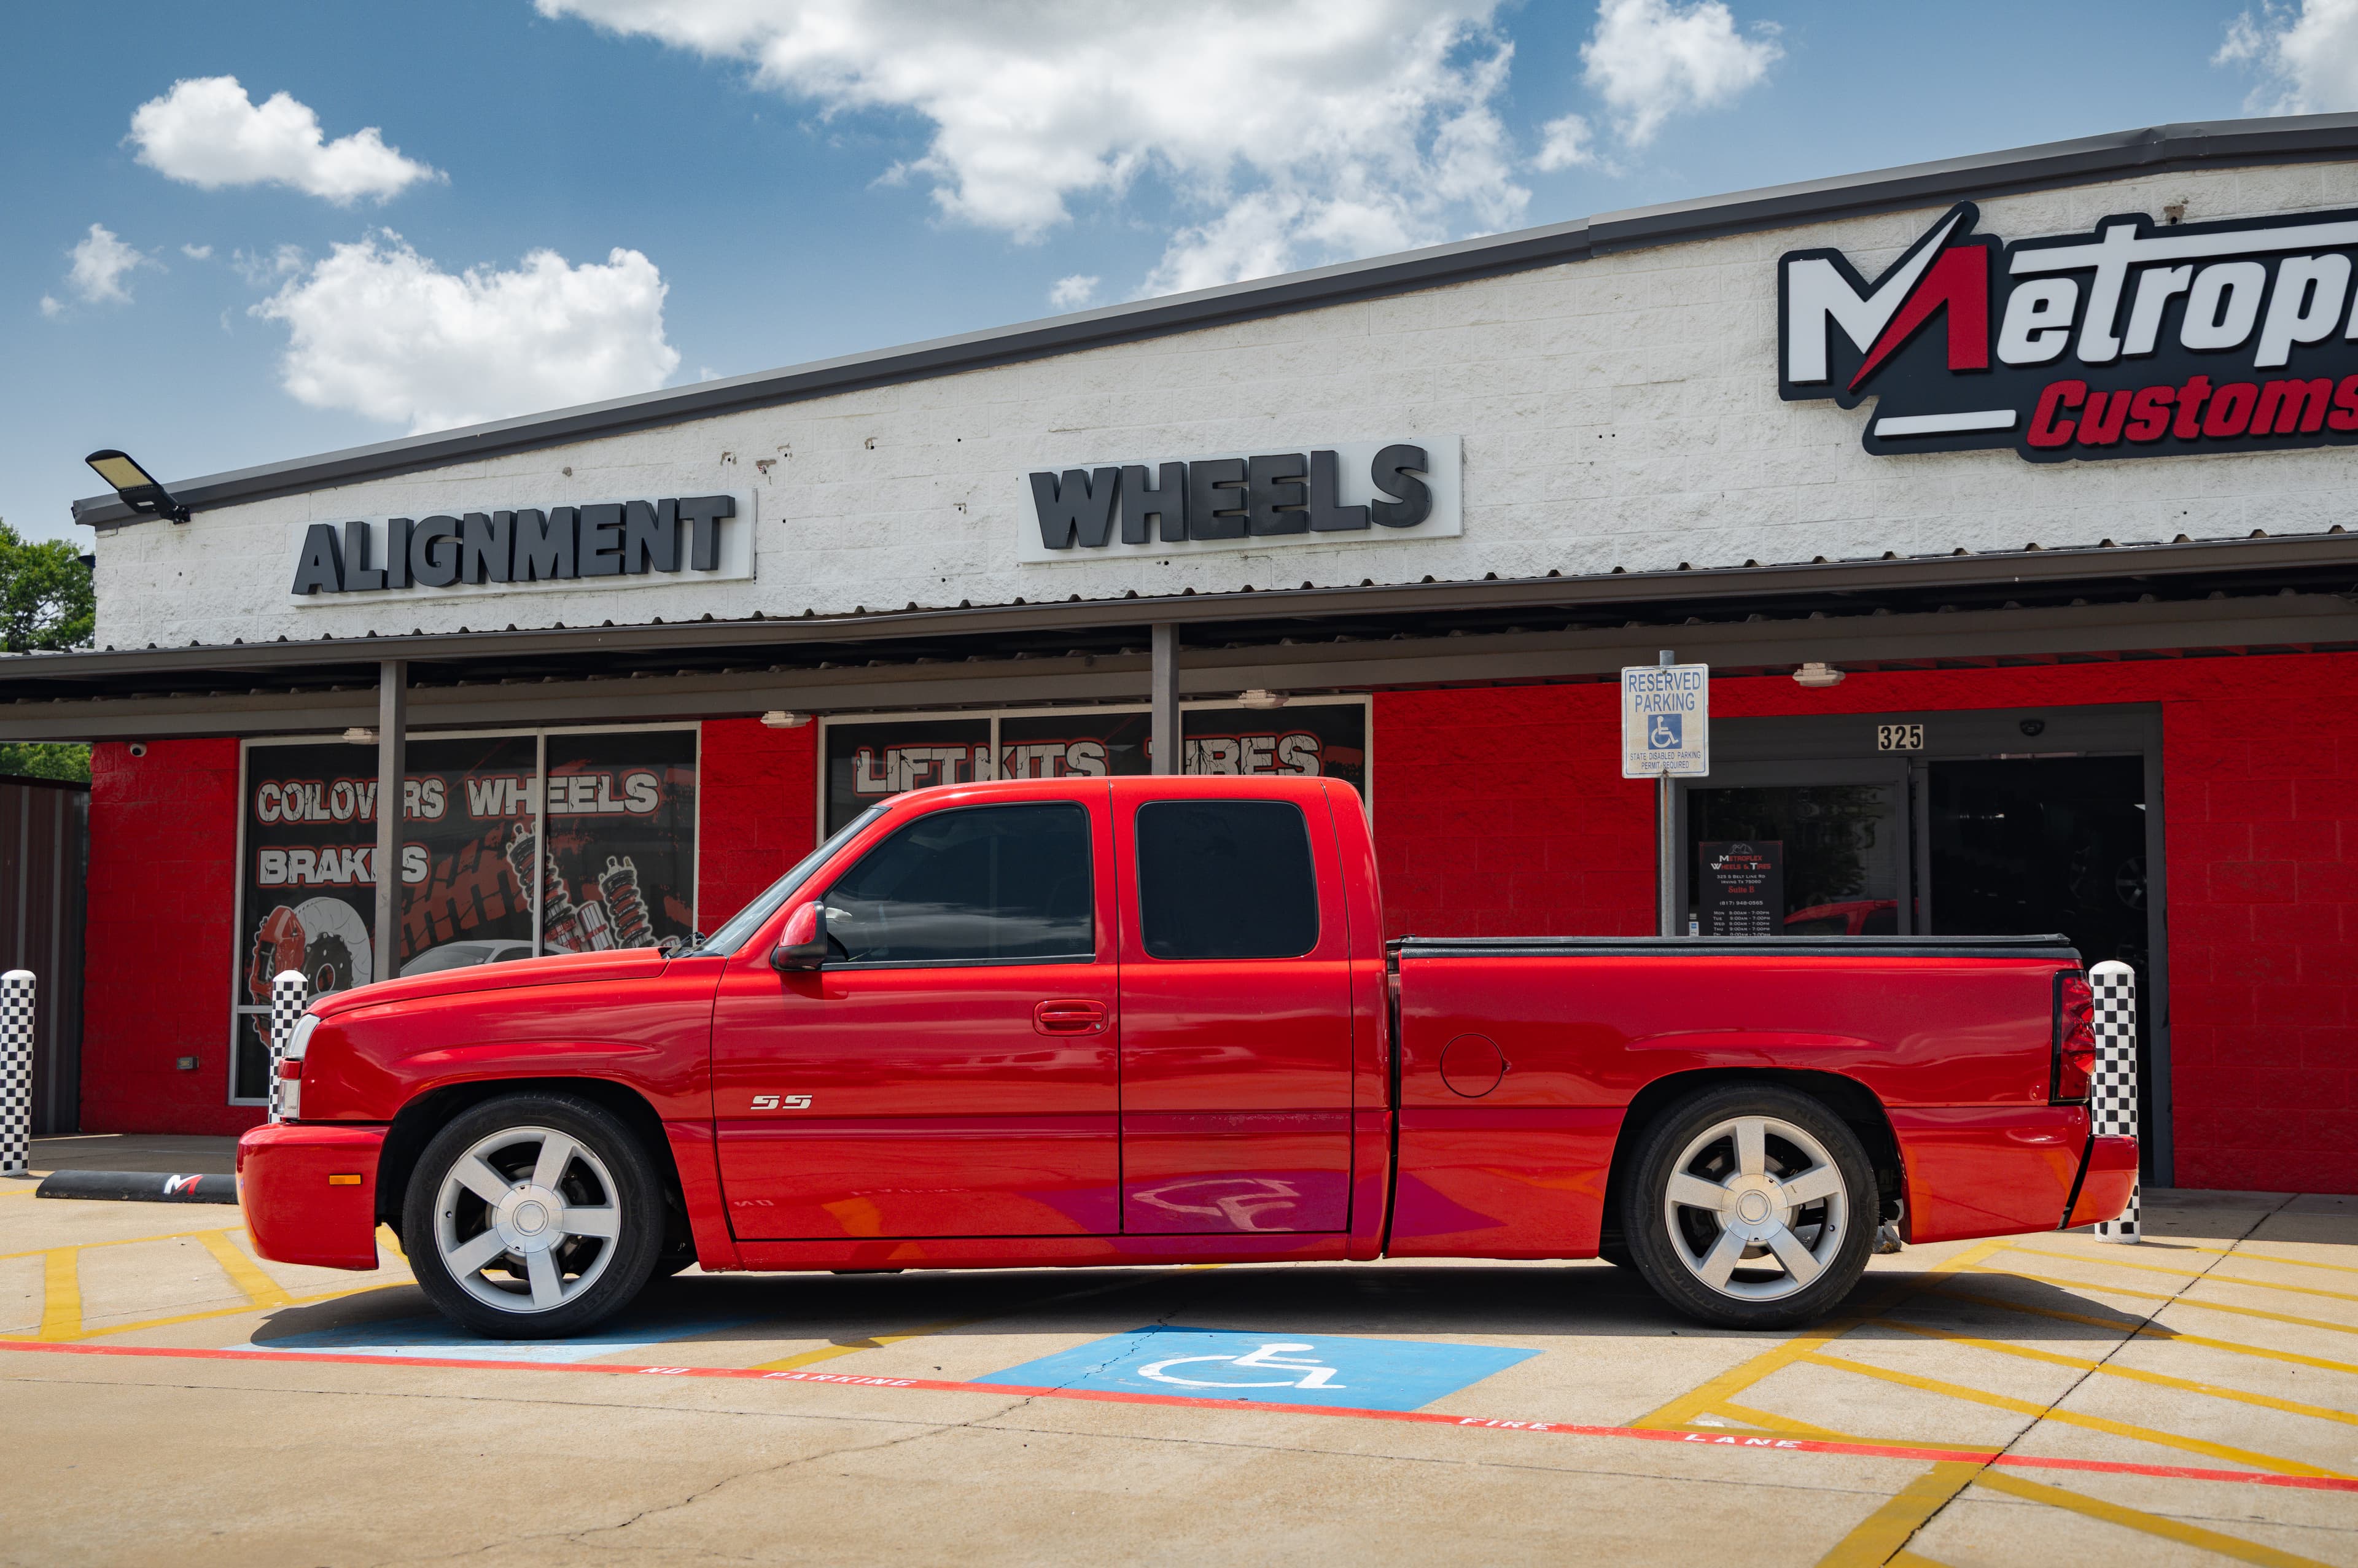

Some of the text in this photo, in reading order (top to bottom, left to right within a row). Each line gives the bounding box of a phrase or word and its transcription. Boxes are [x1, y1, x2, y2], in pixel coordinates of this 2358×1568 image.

[1789, 212, 2358, 391] Metrop
[2026, 373, 2358, 448] Customs
[1029, 443, 1432, 549] WHEELS
[291, 495, 736, 596] ALIGNMENT
[1629, 672, 1701, 693] RESERVED
[1635, 693, 1695, 712] PARKING
[1880, 725, 1921, 749] 325
[856, 734, 1320, 793] LIFT KITS IRES
[1641, 761, 1689, 770] PERMIT REQUIRED
[1649, 751, 1675, 760] DISABLED
[258, 772, 660, 823] COILOVRS WHEELS
[259, 845, 428, 885] BRAKS
[750, 1095, 812, 1109] SS
[1794, 1108, 1851, 1159] NEXEN
[761, 1371, 918, 1387] PARKING
[1458, 1417, 1803, 1449] FIRE LANE
